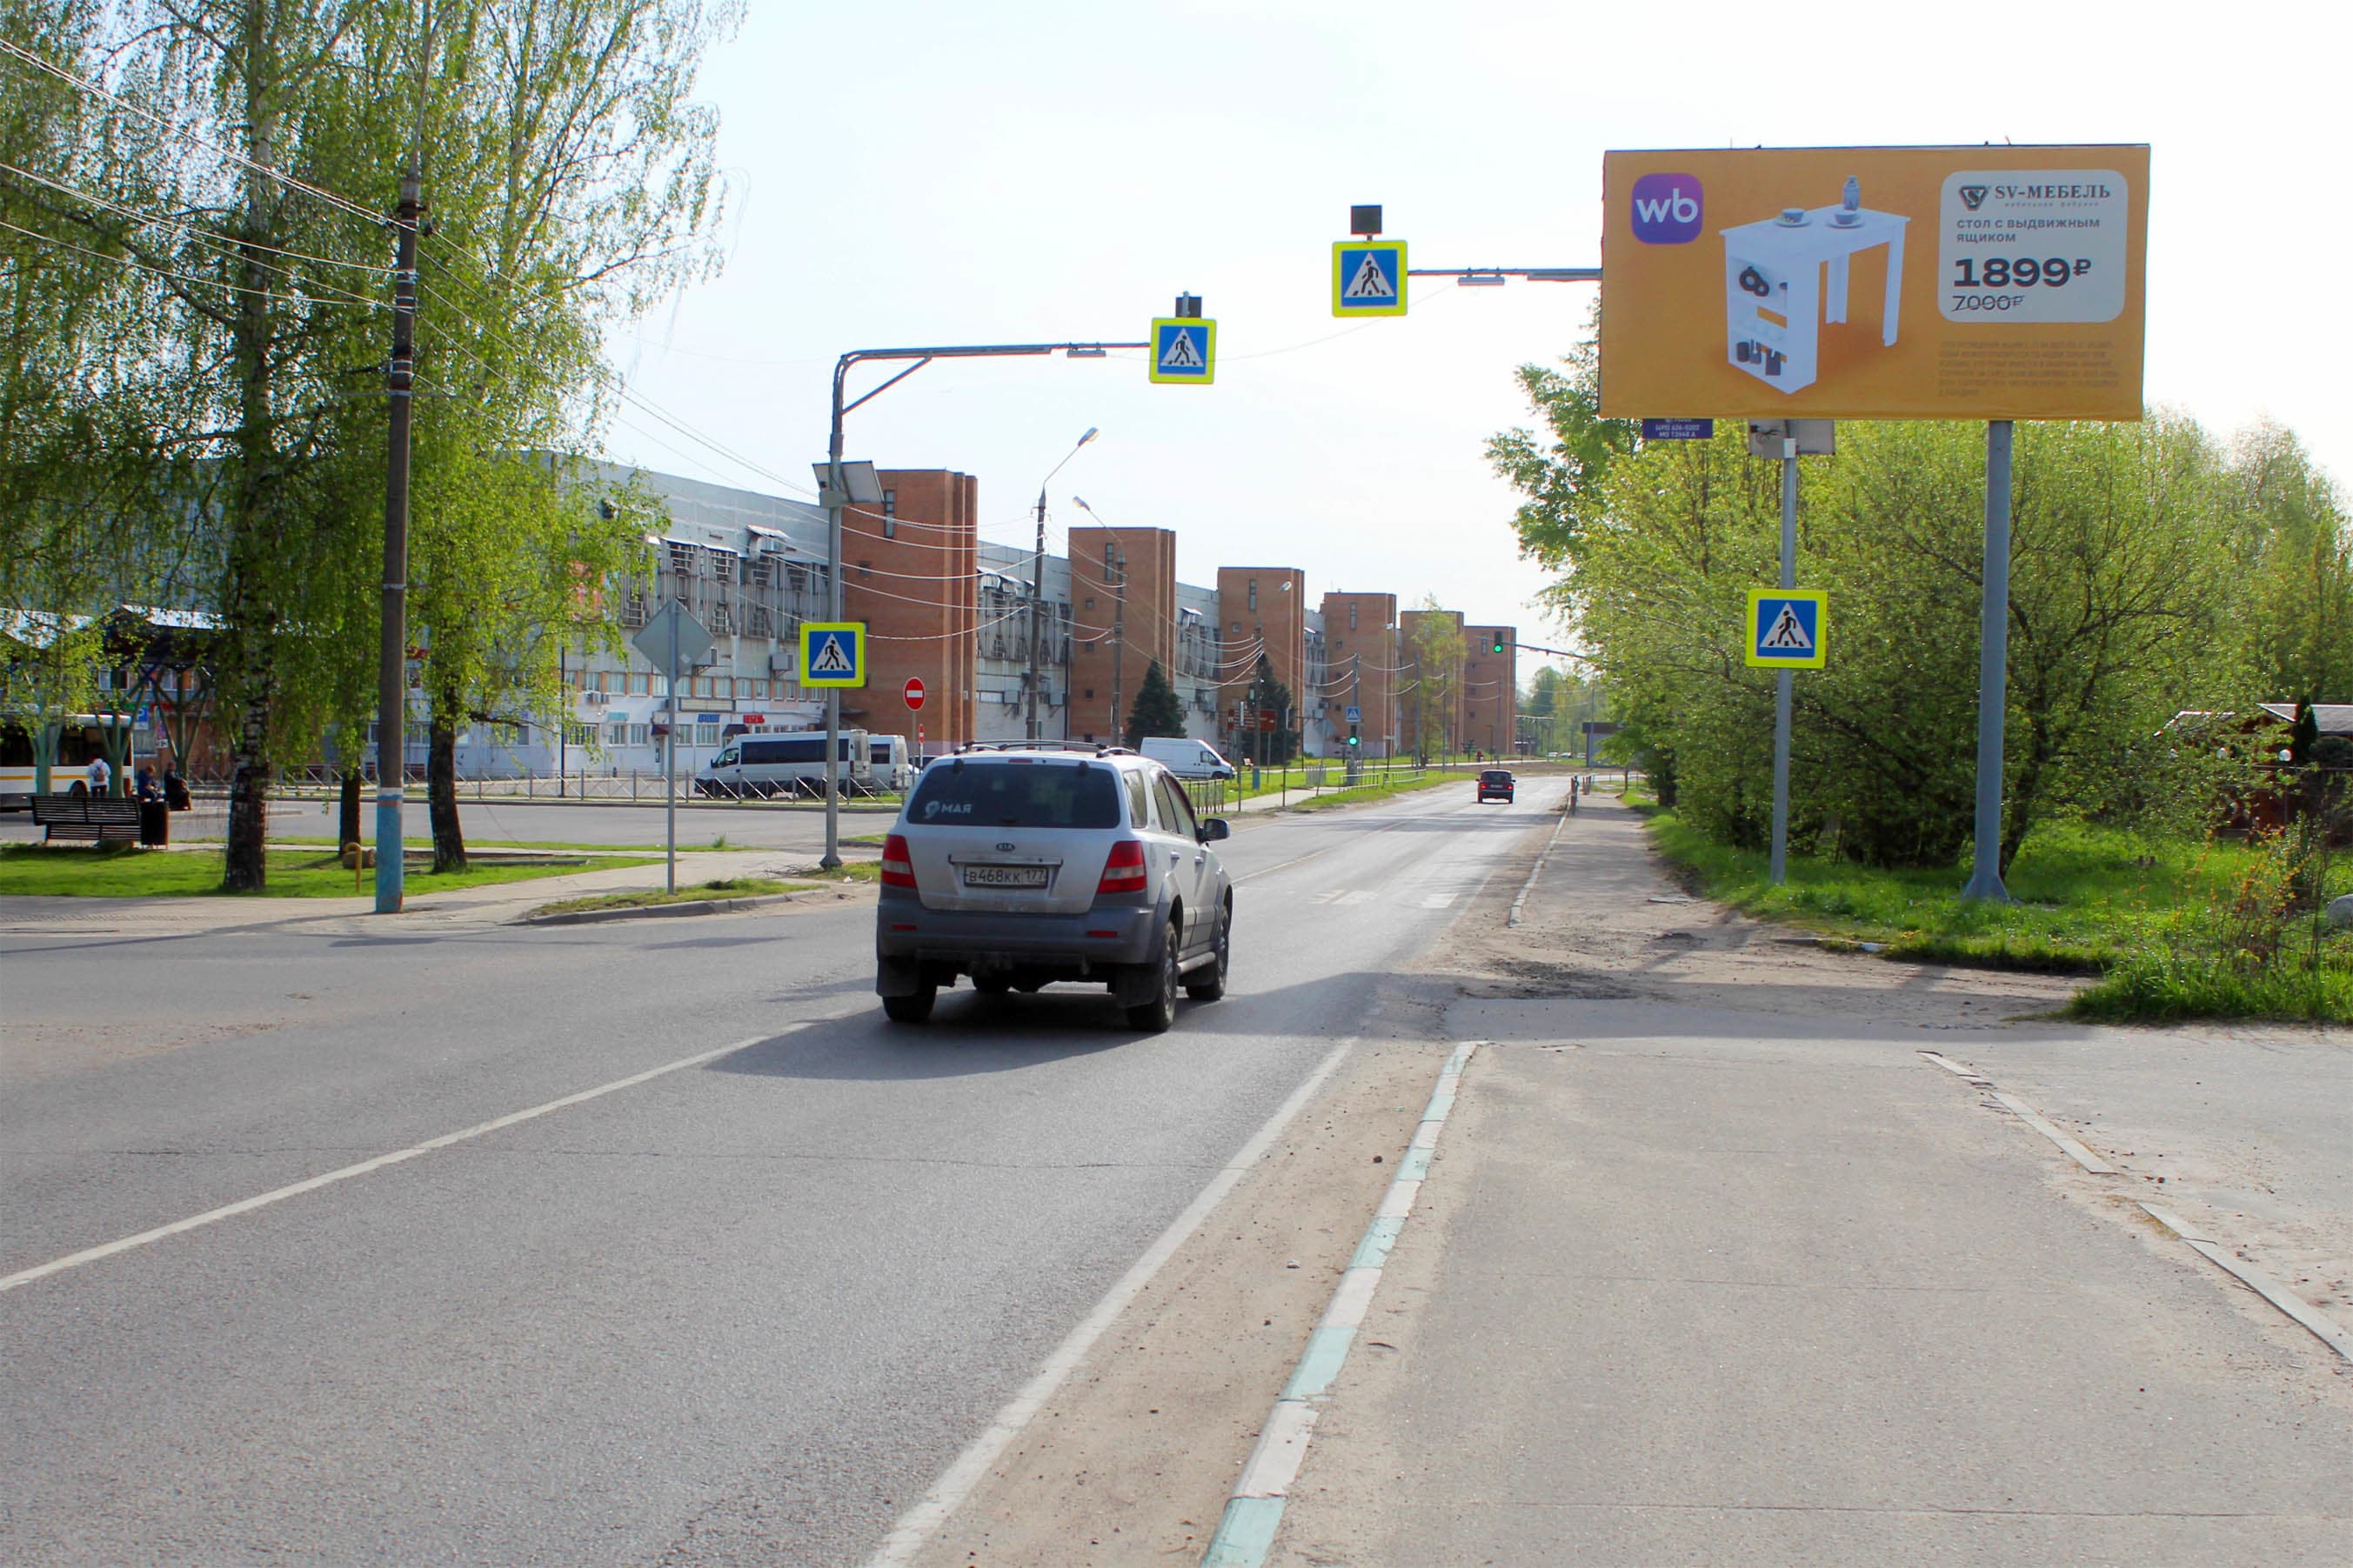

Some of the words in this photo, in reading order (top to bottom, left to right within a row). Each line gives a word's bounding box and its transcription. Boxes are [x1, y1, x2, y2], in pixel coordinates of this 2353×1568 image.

[1995, 184, 2110, 199] SV-МЕБЕЛЬ
[1635, 188, 1698, 223] wb
[940, 803, 973, 813] МАЯ
